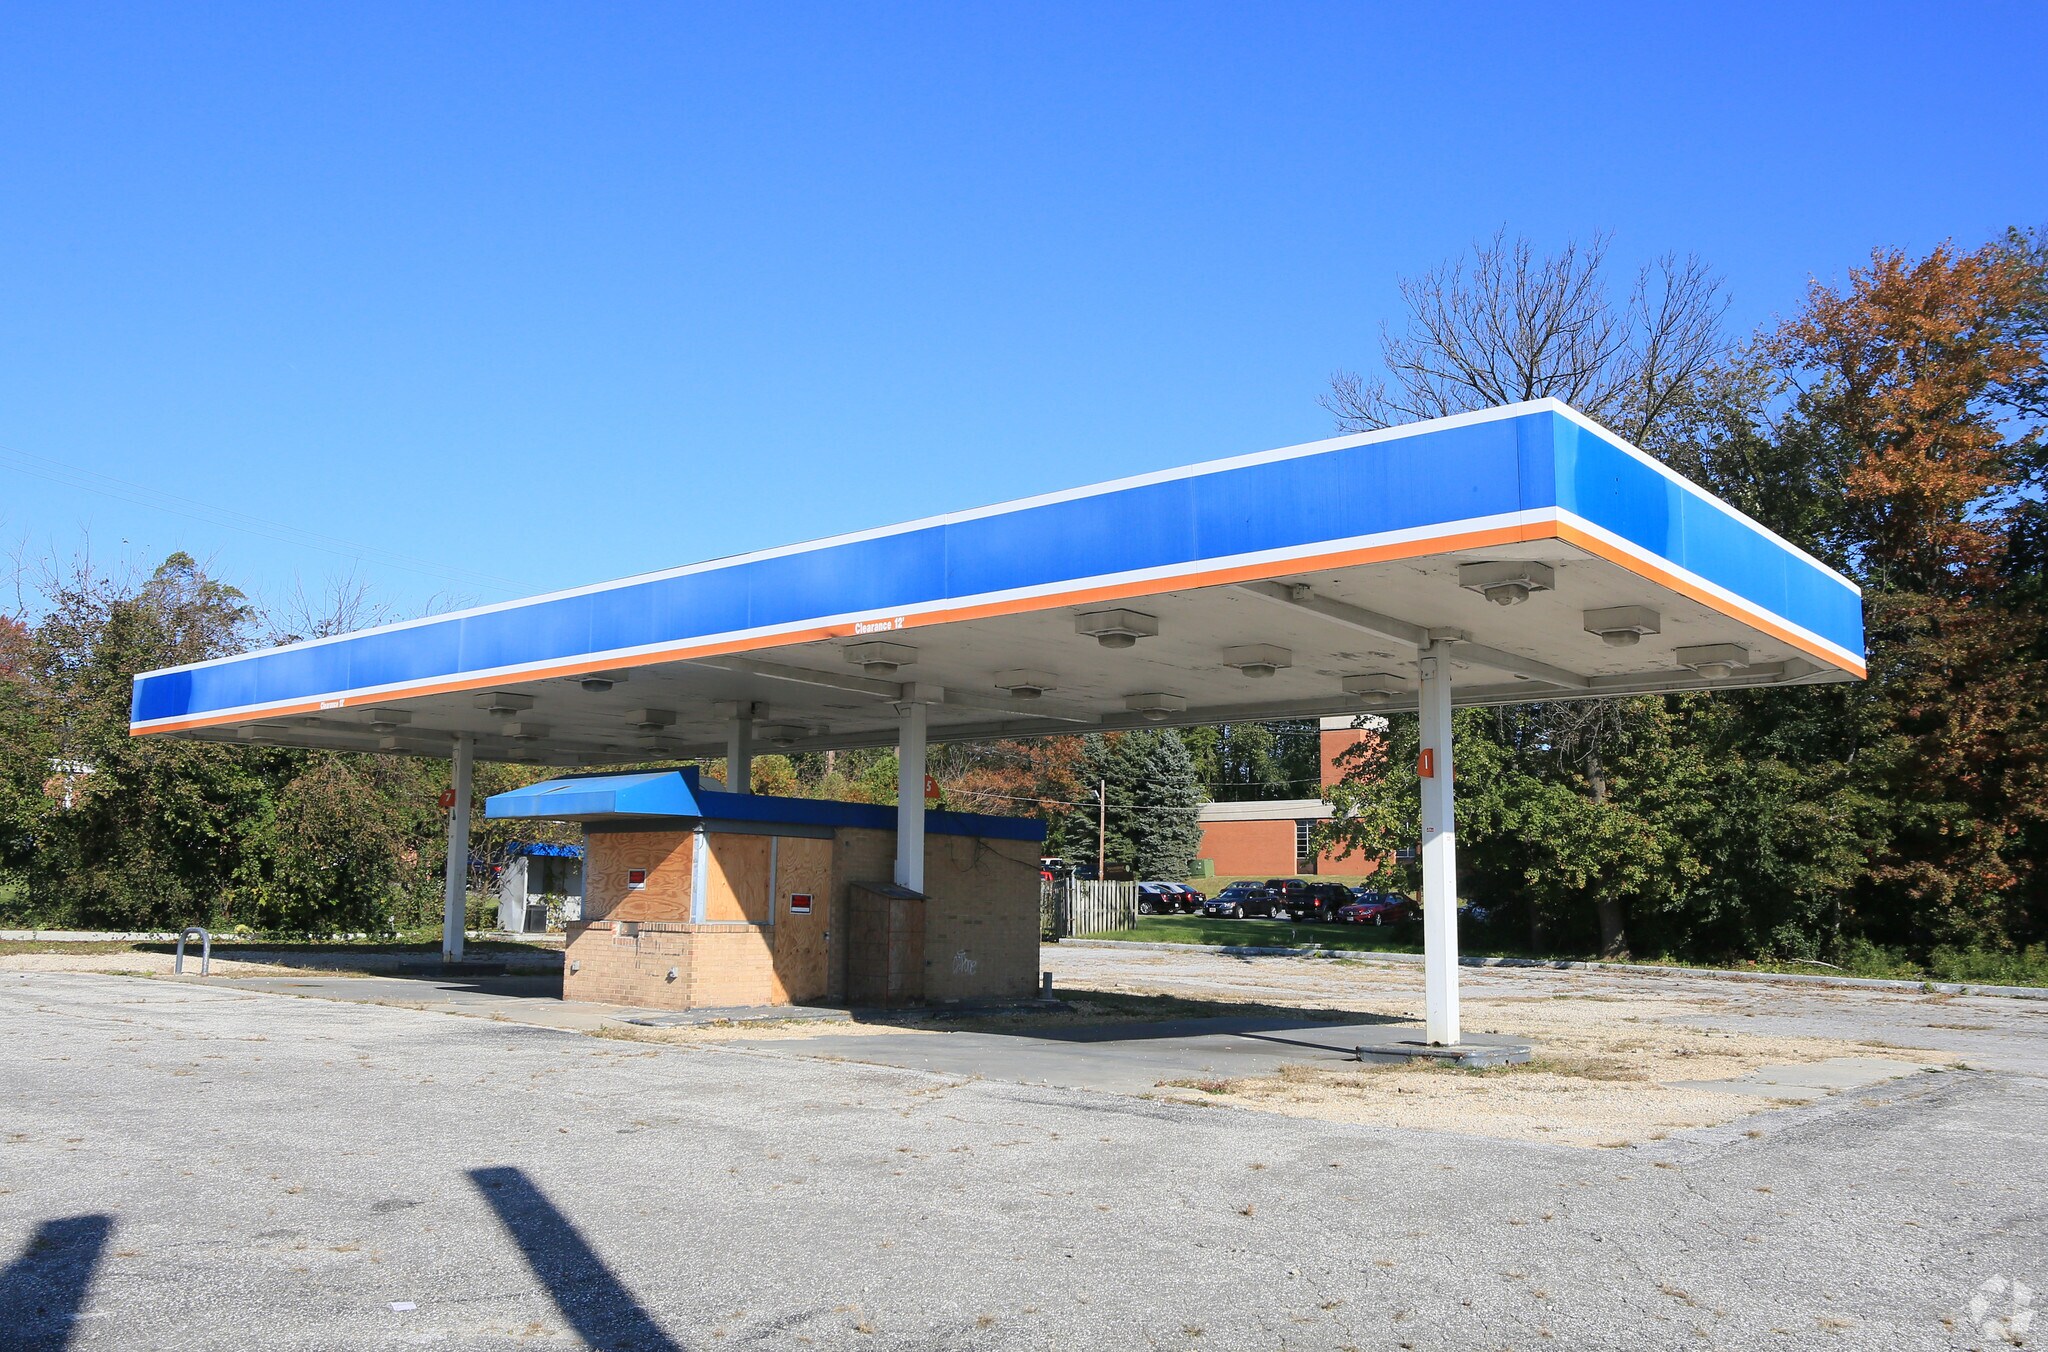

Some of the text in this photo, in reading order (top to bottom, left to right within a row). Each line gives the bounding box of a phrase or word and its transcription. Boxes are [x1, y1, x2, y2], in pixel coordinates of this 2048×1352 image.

[855, 621, 892, 635] Clearance
[926, 780, 932, 792] 5
[445, 792, 452, 802] 7
